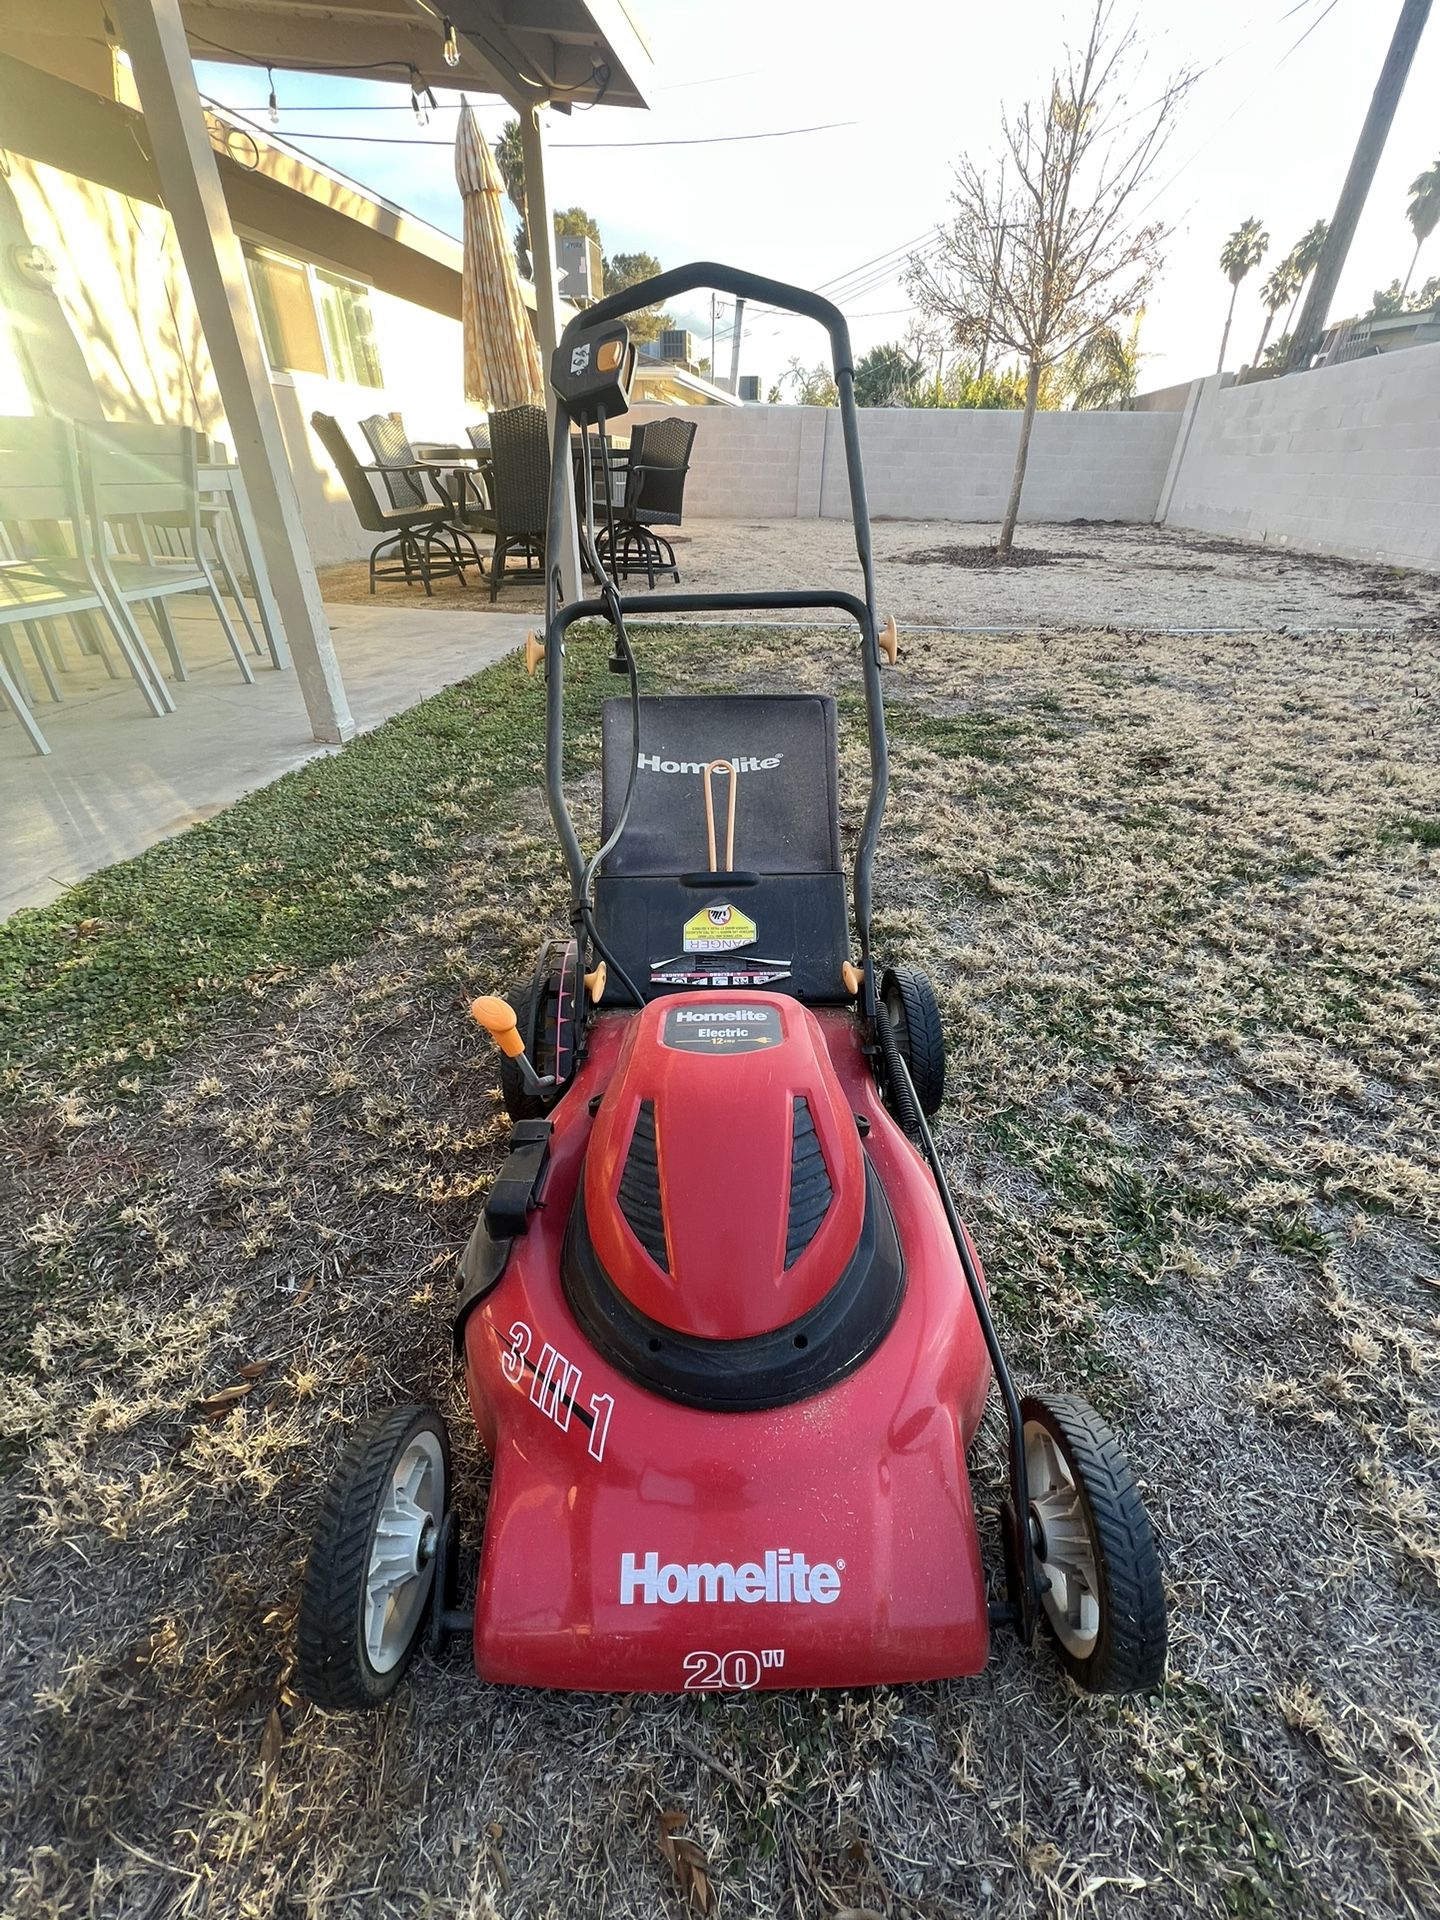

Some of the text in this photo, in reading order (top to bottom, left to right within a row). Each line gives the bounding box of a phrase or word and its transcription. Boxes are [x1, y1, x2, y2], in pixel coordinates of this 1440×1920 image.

[698, 1028, 749, 1038] Electric
[711, 1037, 724, 1045] 12
[501, 1321, 615, 1463] 3 IN 1
